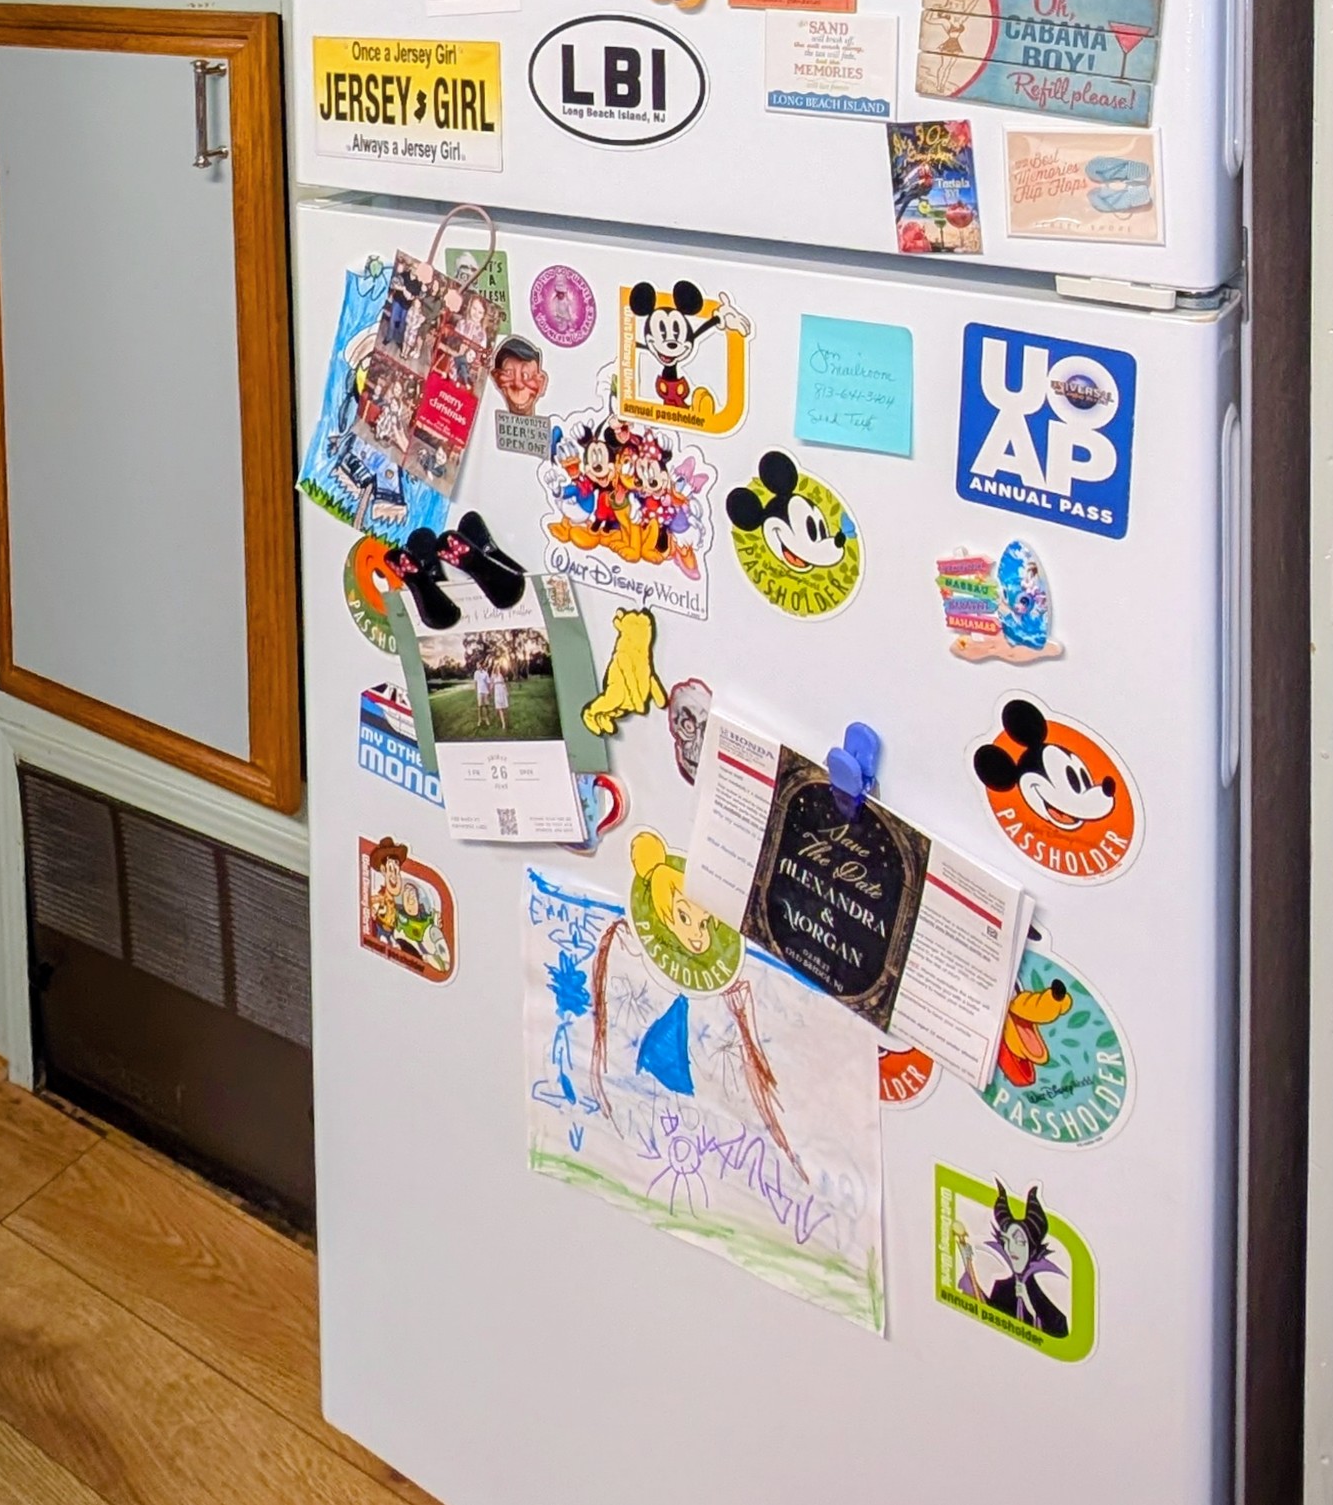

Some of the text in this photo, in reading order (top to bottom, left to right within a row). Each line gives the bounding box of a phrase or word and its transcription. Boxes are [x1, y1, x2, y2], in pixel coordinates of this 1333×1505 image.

[809, 21, 849, 36] SAND
[1005, 14, 1108, 51] CABANA
[352, 41, 458, 69] Once Jersey Girl
[1022, 46, 1096, 73] BOY!
[561, 43, 666, 111] LBI
[794, 63, 863, 79] MEMORIES
[320, 72, 495, 132] JERSEY GIRL
[773, 94, 885, 113] LONG BEACH ISLAND
[1007, 72, 1137, 110] Refill please!
[562, 104, 666, 123] Long Beach Island, NJ
[352, 134, 438, 163] Always Jersey
[1030, 149, 1060, 169] Best
[1014, 162, 1079, 185] Memories
[1014, 178, 1088, 203] Flip Flops
[429, 398, 467, 426] christmas
[439, 391, 463, 411] merry
[624, 402, 705, 427] annual passholder
[499, 424, 536, 437] BEER'S
[509, 416, 548, 429] FAVORITE
[499, 438, 547, 454] OPEN ONE
[969, 477, 1113, 524] ANNUAL PASS
[738, 546, 848, 613] PASSHOLDER
[949, 617, 997, 633] BAHAMAS
[361, 727, 382, 747] MY
[728, 731, 775, 760] HONDA
[491, 765, 508, 780] 26
[818, 824, 870, 857] Save
[997, 808, 1128, 874] PASSHOLDER
[798, 832, 882, 899] The Date
[779, 857, 886, 938] ALEXANDRA
[821, 907, 834, 928] &
[782, 898, 863, 968] MORGAN
[636, 921, 733, 990] PASSHOLDER
[993, 1051, 1126, 1140] PASSHOLDER
[941, 1290, 1044, 1347] annual passholder
